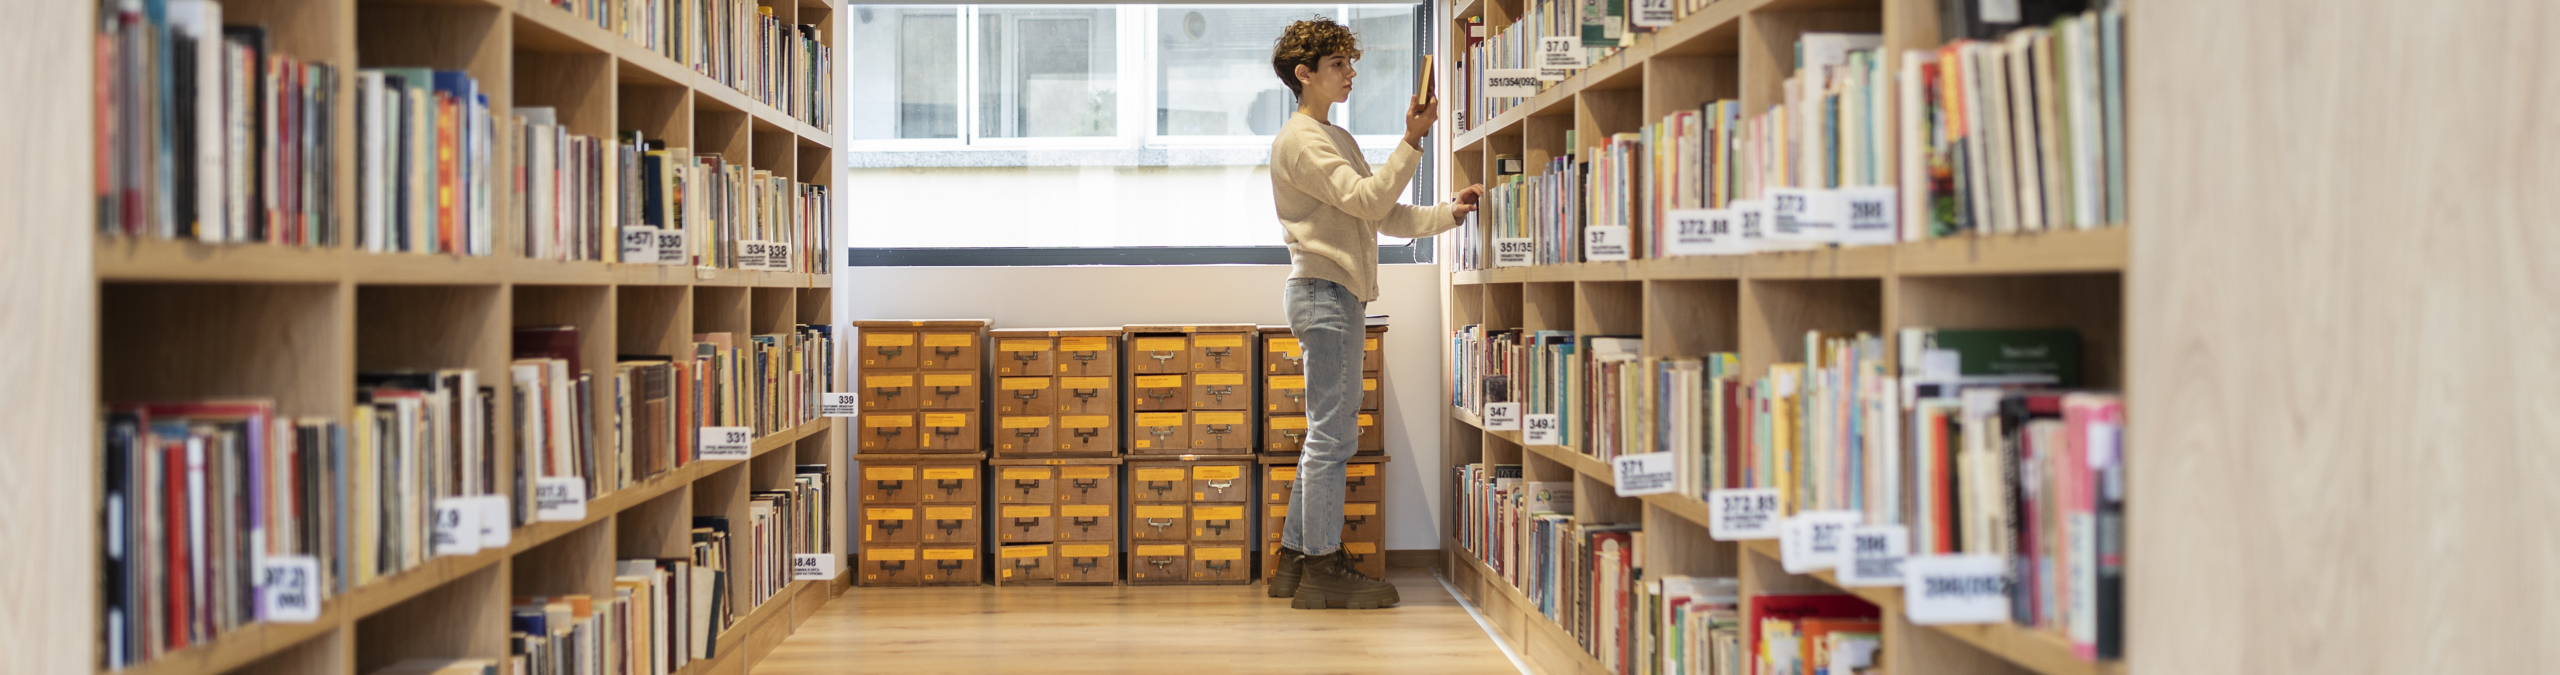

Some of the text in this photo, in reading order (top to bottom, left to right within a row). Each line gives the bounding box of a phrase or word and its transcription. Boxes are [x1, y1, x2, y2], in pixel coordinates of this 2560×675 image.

[1545, 40, 1570, 52] 37.0
[658, 234, 682, 248] 330
[1590, 231, 1605, 243] 37
[746, 244, 766, 255] 334
[768, 245, 787, 257] 338
[838, 395, 854, 405] 339
[1490, 406, 1507, 417] 347
[726, 431, 746, 444] 331
[1620, 459, 1644, 475] 371
